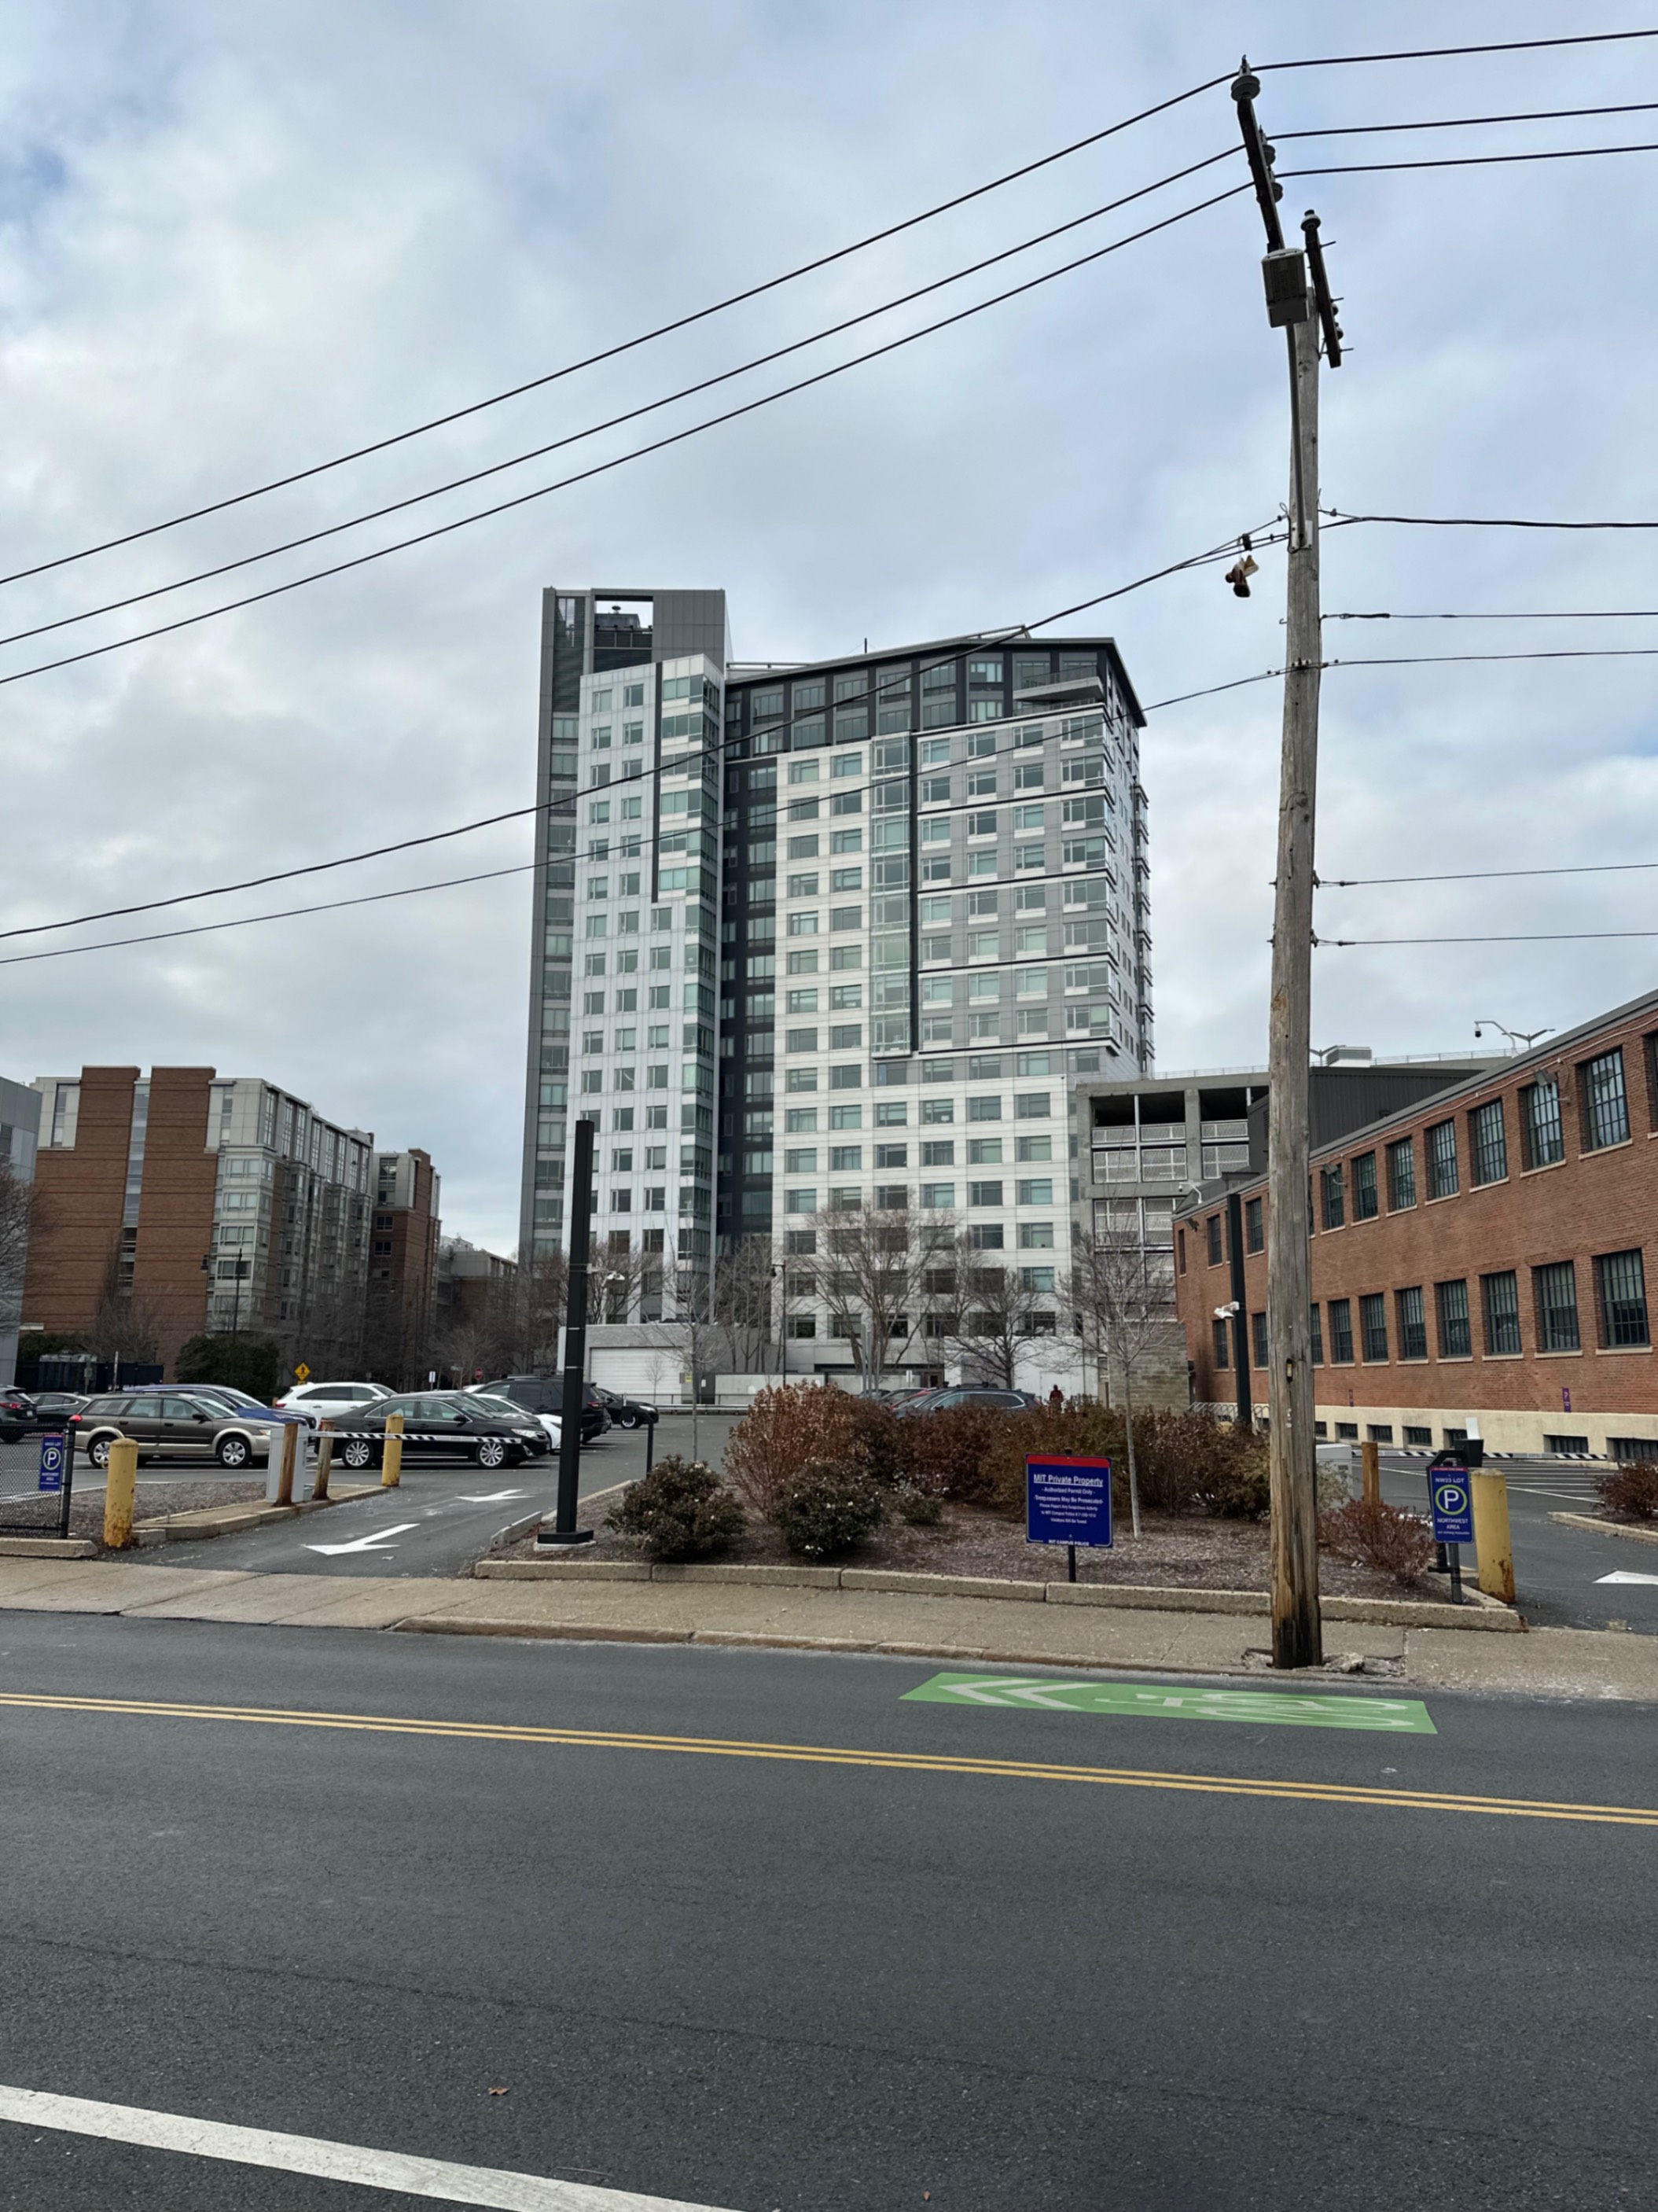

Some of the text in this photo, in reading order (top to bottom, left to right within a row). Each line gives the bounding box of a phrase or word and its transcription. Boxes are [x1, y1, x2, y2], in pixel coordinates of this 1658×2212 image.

[1034, 1474, 1103, 1486] MIT Private Property
[1444, 1489, 1459, 1509] P
